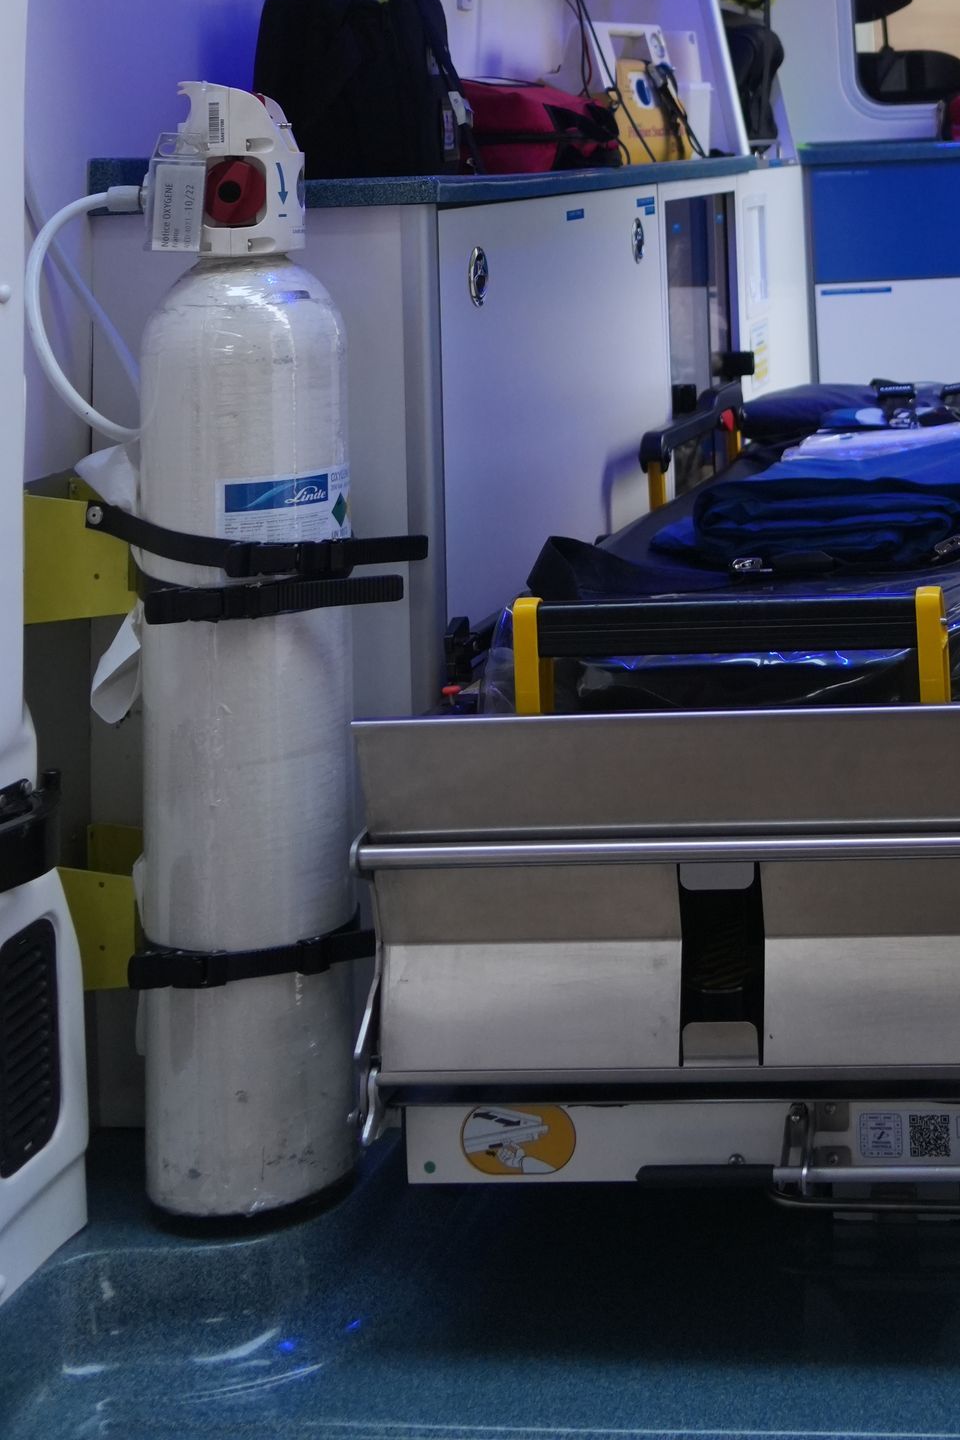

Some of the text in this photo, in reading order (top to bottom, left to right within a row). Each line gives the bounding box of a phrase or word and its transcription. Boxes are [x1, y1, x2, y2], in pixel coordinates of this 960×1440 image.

[183, 184, 195, 211] 10/22
[161, 183, 174, 247] Notice OXYGENE
[284, 485, 327, 504] Linde
